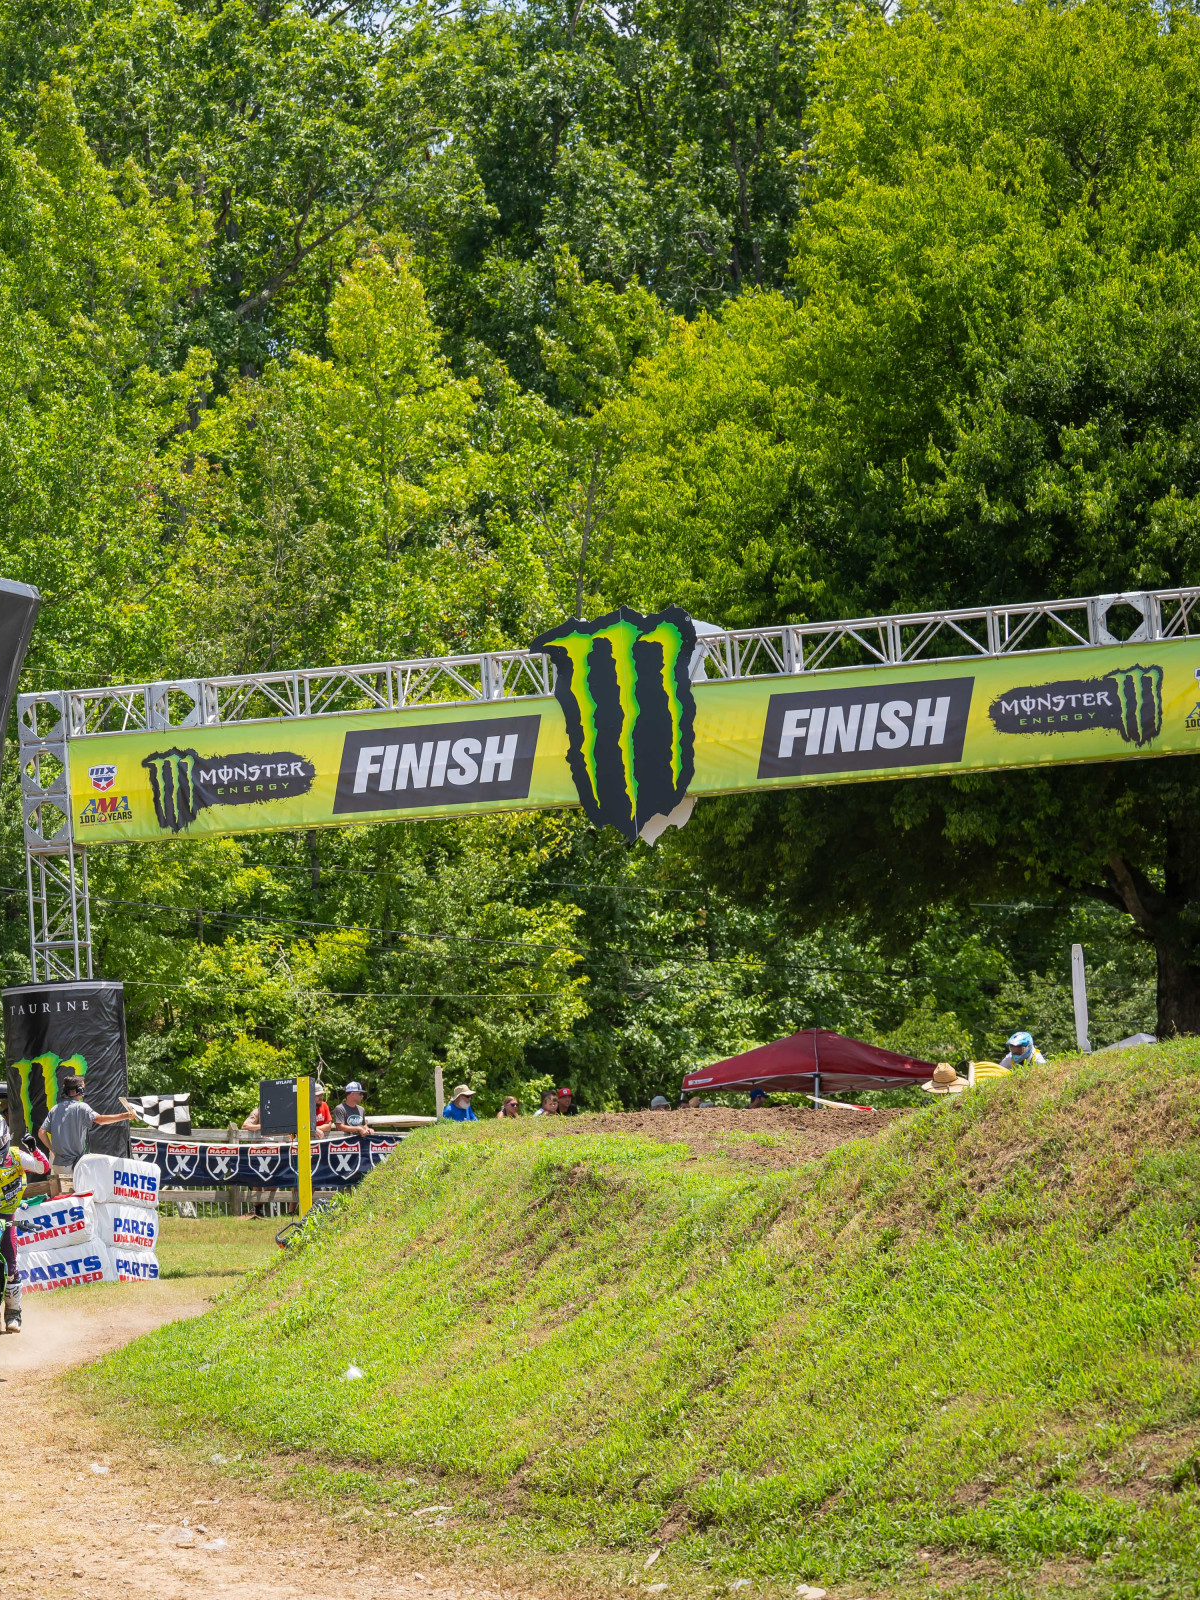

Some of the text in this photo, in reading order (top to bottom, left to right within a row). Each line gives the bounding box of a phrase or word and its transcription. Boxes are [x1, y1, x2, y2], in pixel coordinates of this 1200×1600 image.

[1000, 691, 1113, 716] MONSTER
[778, 696, 951, 759] FINISH
[1019, 712, 1096, 726] ENERGY
[199, 761, 306, 785] MONSTER
[352, 734, 518, 794] FINISH
[217, 782, 290, 795] ENERGY
[80, 795, 131, 815] AMA
[80, 814, 96, 824] 100
[107, 811, 133, 821] YEARS
[10, 1000, 90, 1016] TAURINE
[172, 1155, 191, 1172] X
[213, 1156, 235, 1173] X
[257, 1156, 272, 1173] X
[336, 1154, 352, 1172] X
[113, 1170, 157, 1192] PARTS
[113, 1186, 156, 1202] UNLIMITED
[17, 1220, 86, 1247] NLIMITED
[113, 1217, 155, 1238] PARTS
[113, 1233, 154, 1248] UNLIMITED
[116, 1258, 159, 1279] PARTS
